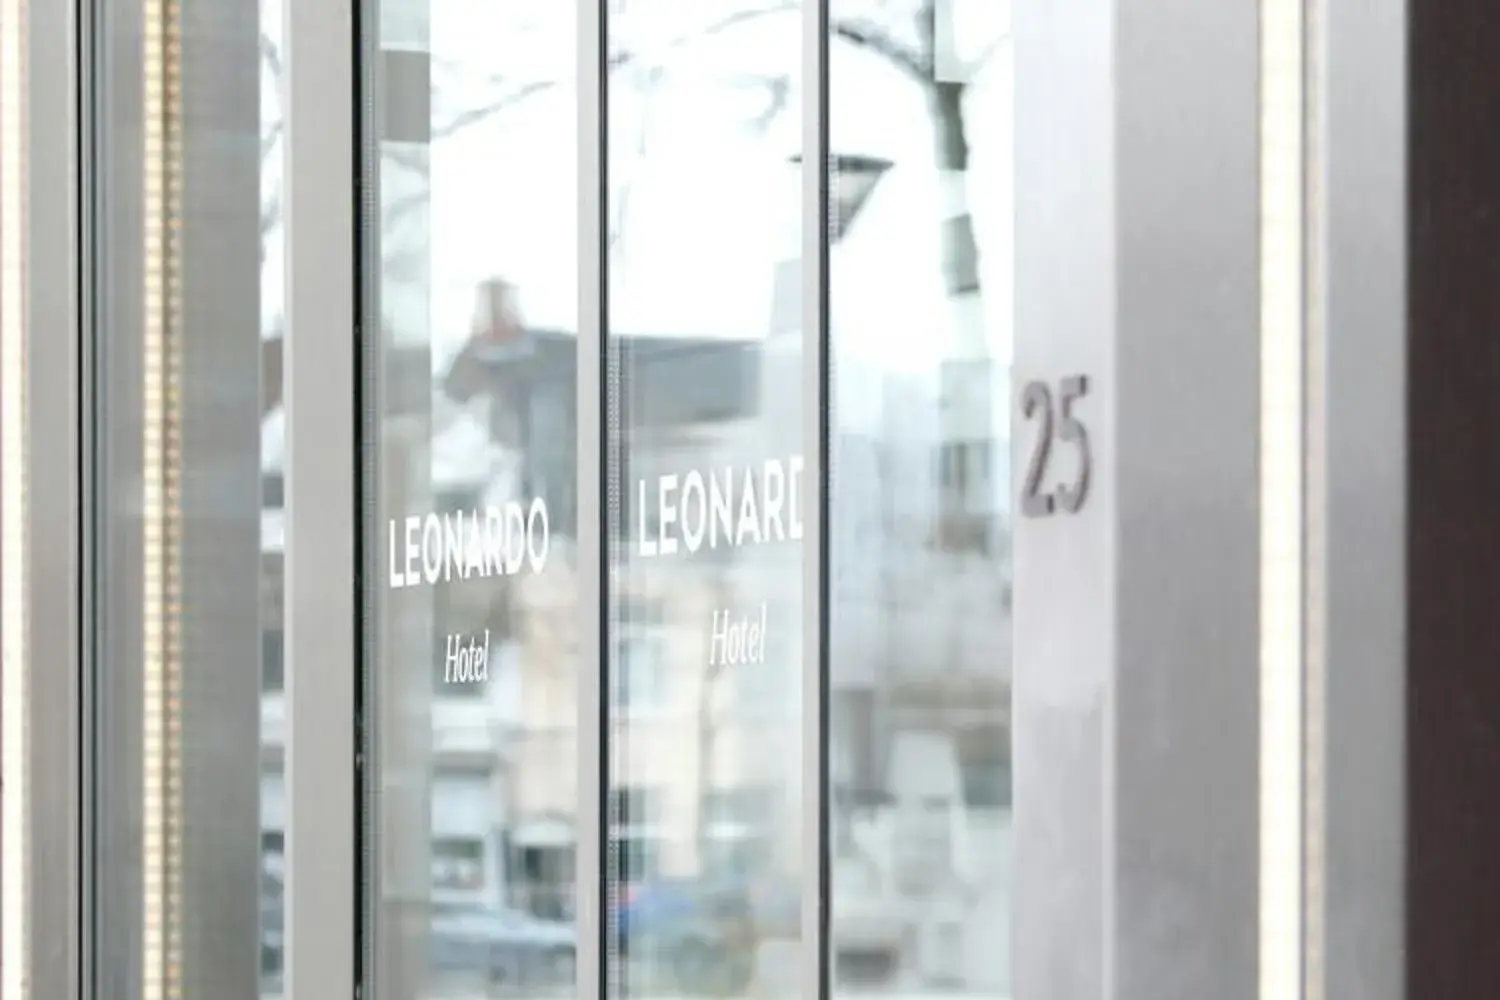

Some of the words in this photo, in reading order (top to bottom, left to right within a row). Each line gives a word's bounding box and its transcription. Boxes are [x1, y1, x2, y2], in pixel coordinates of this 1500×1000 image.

[1021, 374, 1092, 520] 25
[388, 497, 549, 588] LEONARDO
[638, 455, 804, 557] LEONARD
[444, 629, 490, 684] Hotel
[708, 603, 767, 666] Hotel
